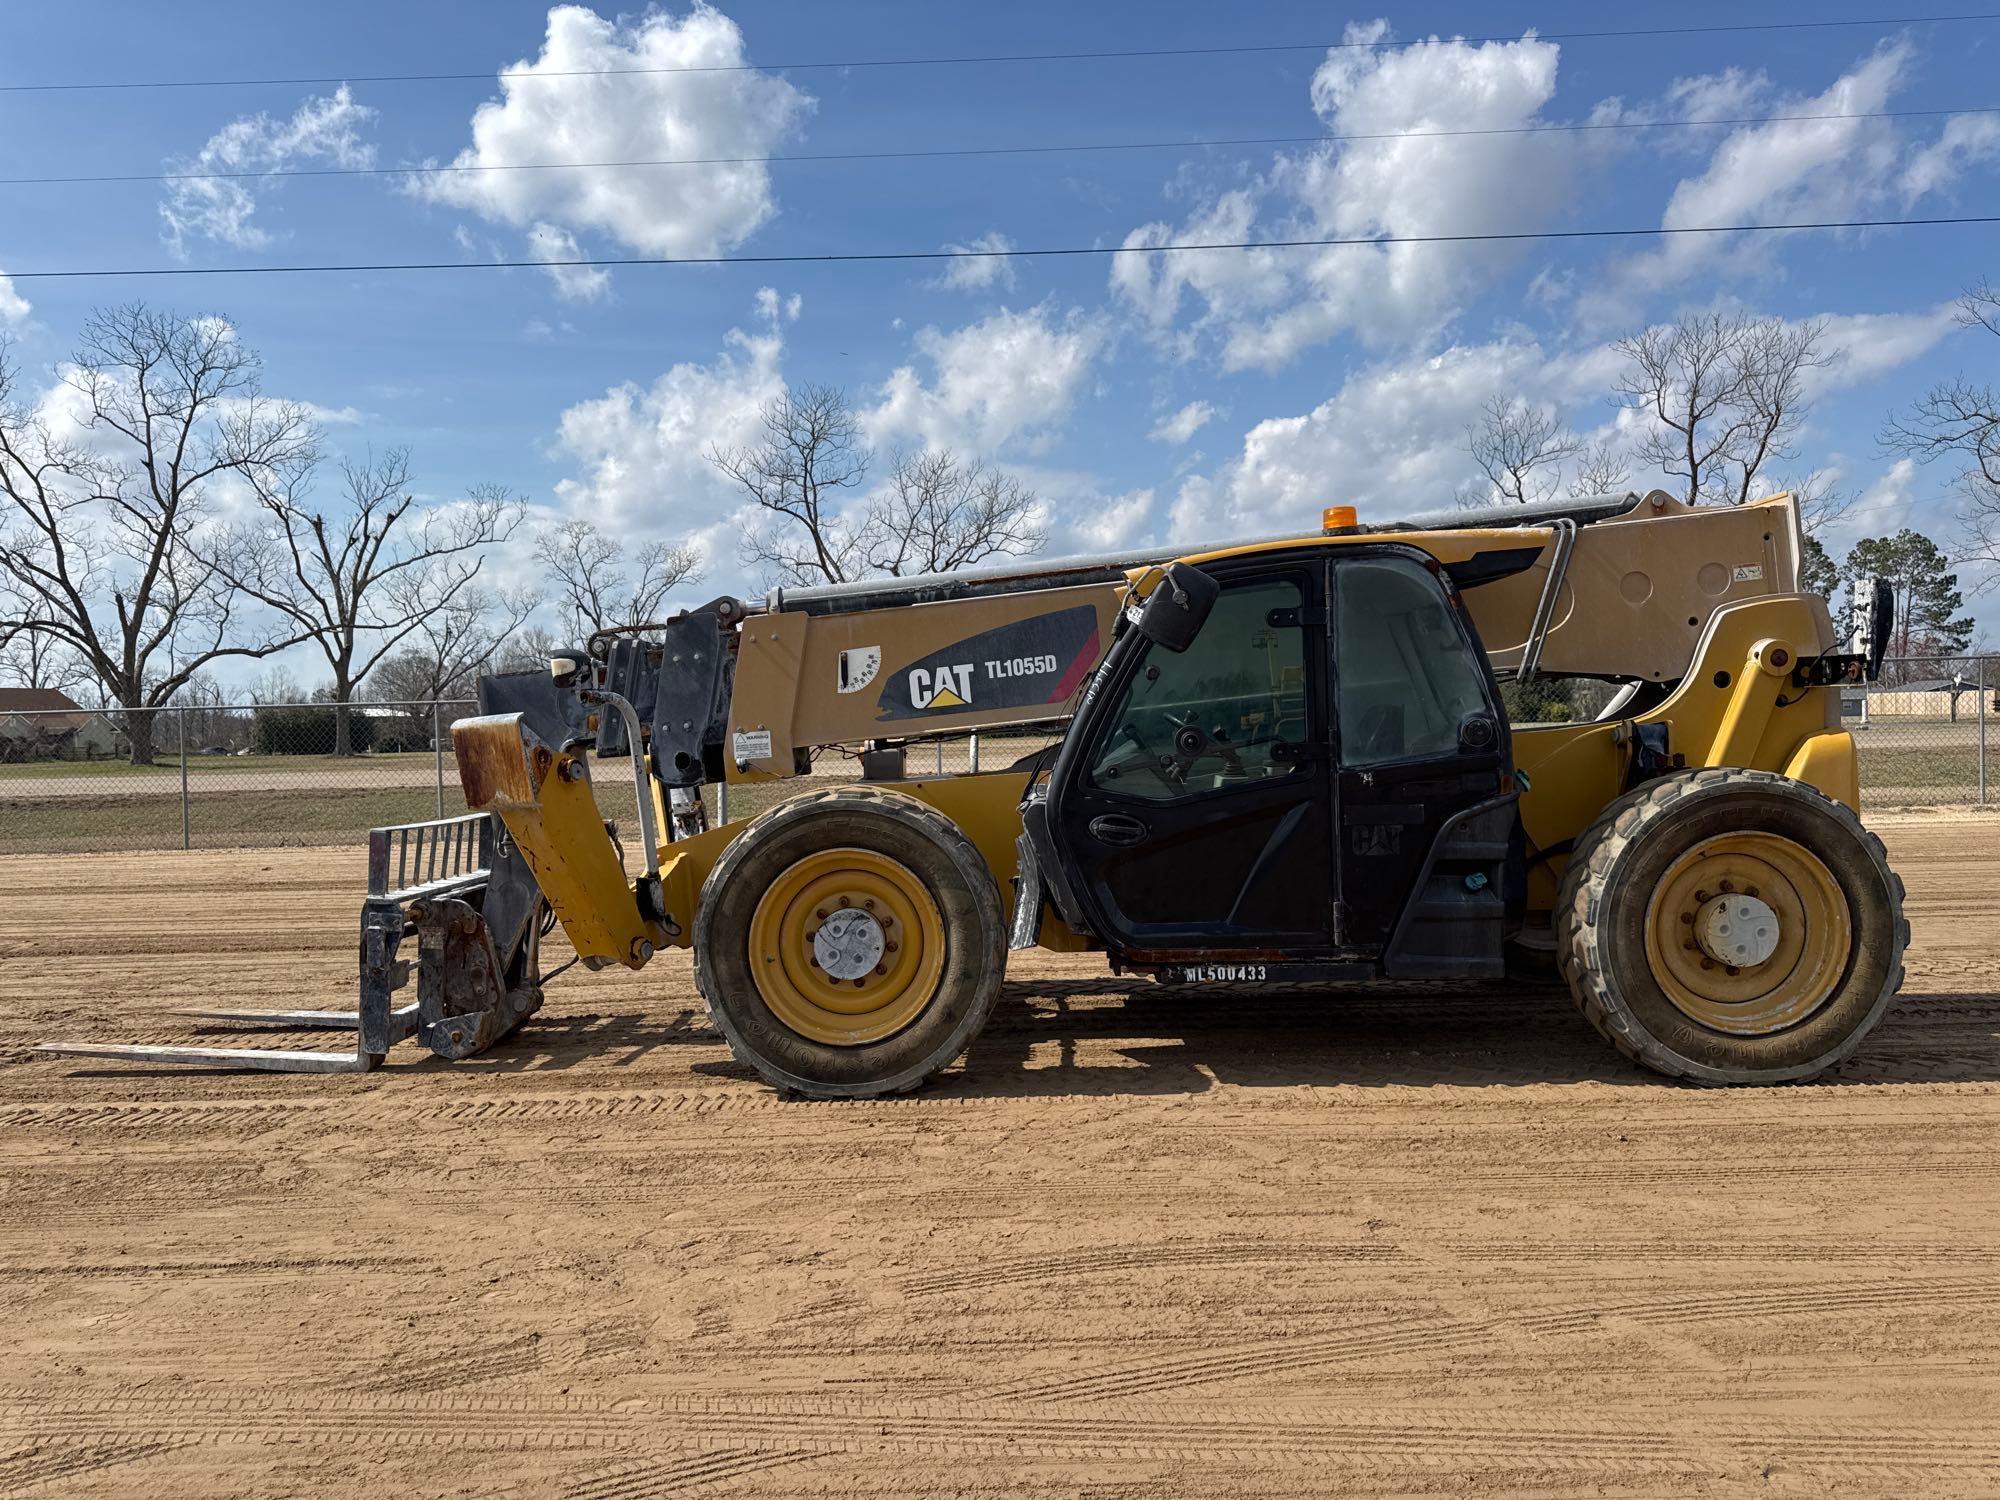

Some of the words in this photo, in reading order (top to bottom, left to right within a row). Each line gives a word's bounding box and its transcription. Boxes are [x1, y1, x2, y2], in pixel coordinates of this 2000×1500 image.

[984, 654, 1057, 679] TL1055D
[908, 663, 975, 710] CAT
[1351, 824, 1404, 857] CAT
